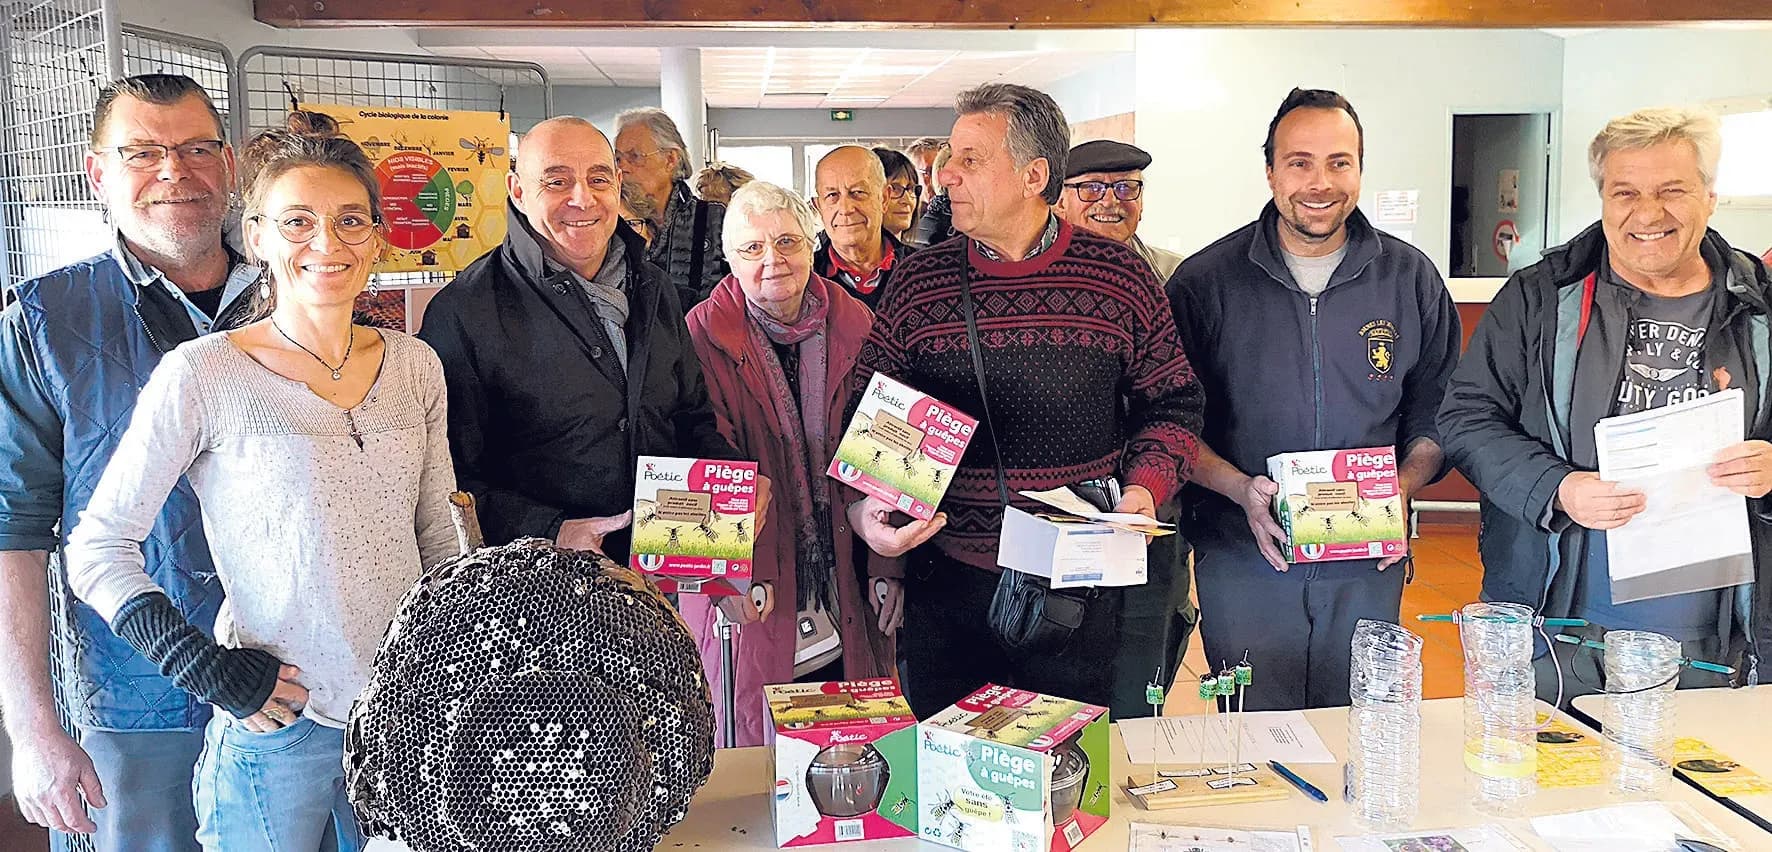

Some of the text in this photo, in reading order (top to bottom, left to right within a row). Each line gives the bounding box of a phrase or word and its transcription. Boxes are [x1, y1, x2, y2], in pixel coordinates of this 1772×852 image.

[359, 110, 377, 118] Cycle
[378, 112, 410, 120] biologique
[1670, 348, 1681, 360] &
[1618, 380, 1656, 409] UTY
[926, 404, 972, 435] Piège
[920, 420, 928, 430] à
[927, 426, 966, 449] guêpes
[1346, 453, 1394, 468] Piège
[704, 464, 755, 484] Piège
[1346, 469, 1396, 482] à guêpes
[703, 482, 754, 495] à guêpes
[965, 686, 1004, 705] Piège
[981, 744, 1036, 775] Piège
[980, 767, 1036, 789] à guêpes
[961, 788, 980, 798] Votre
[966, 798, 988, 808] sans
[965, 808, 986, 816] guêpe
